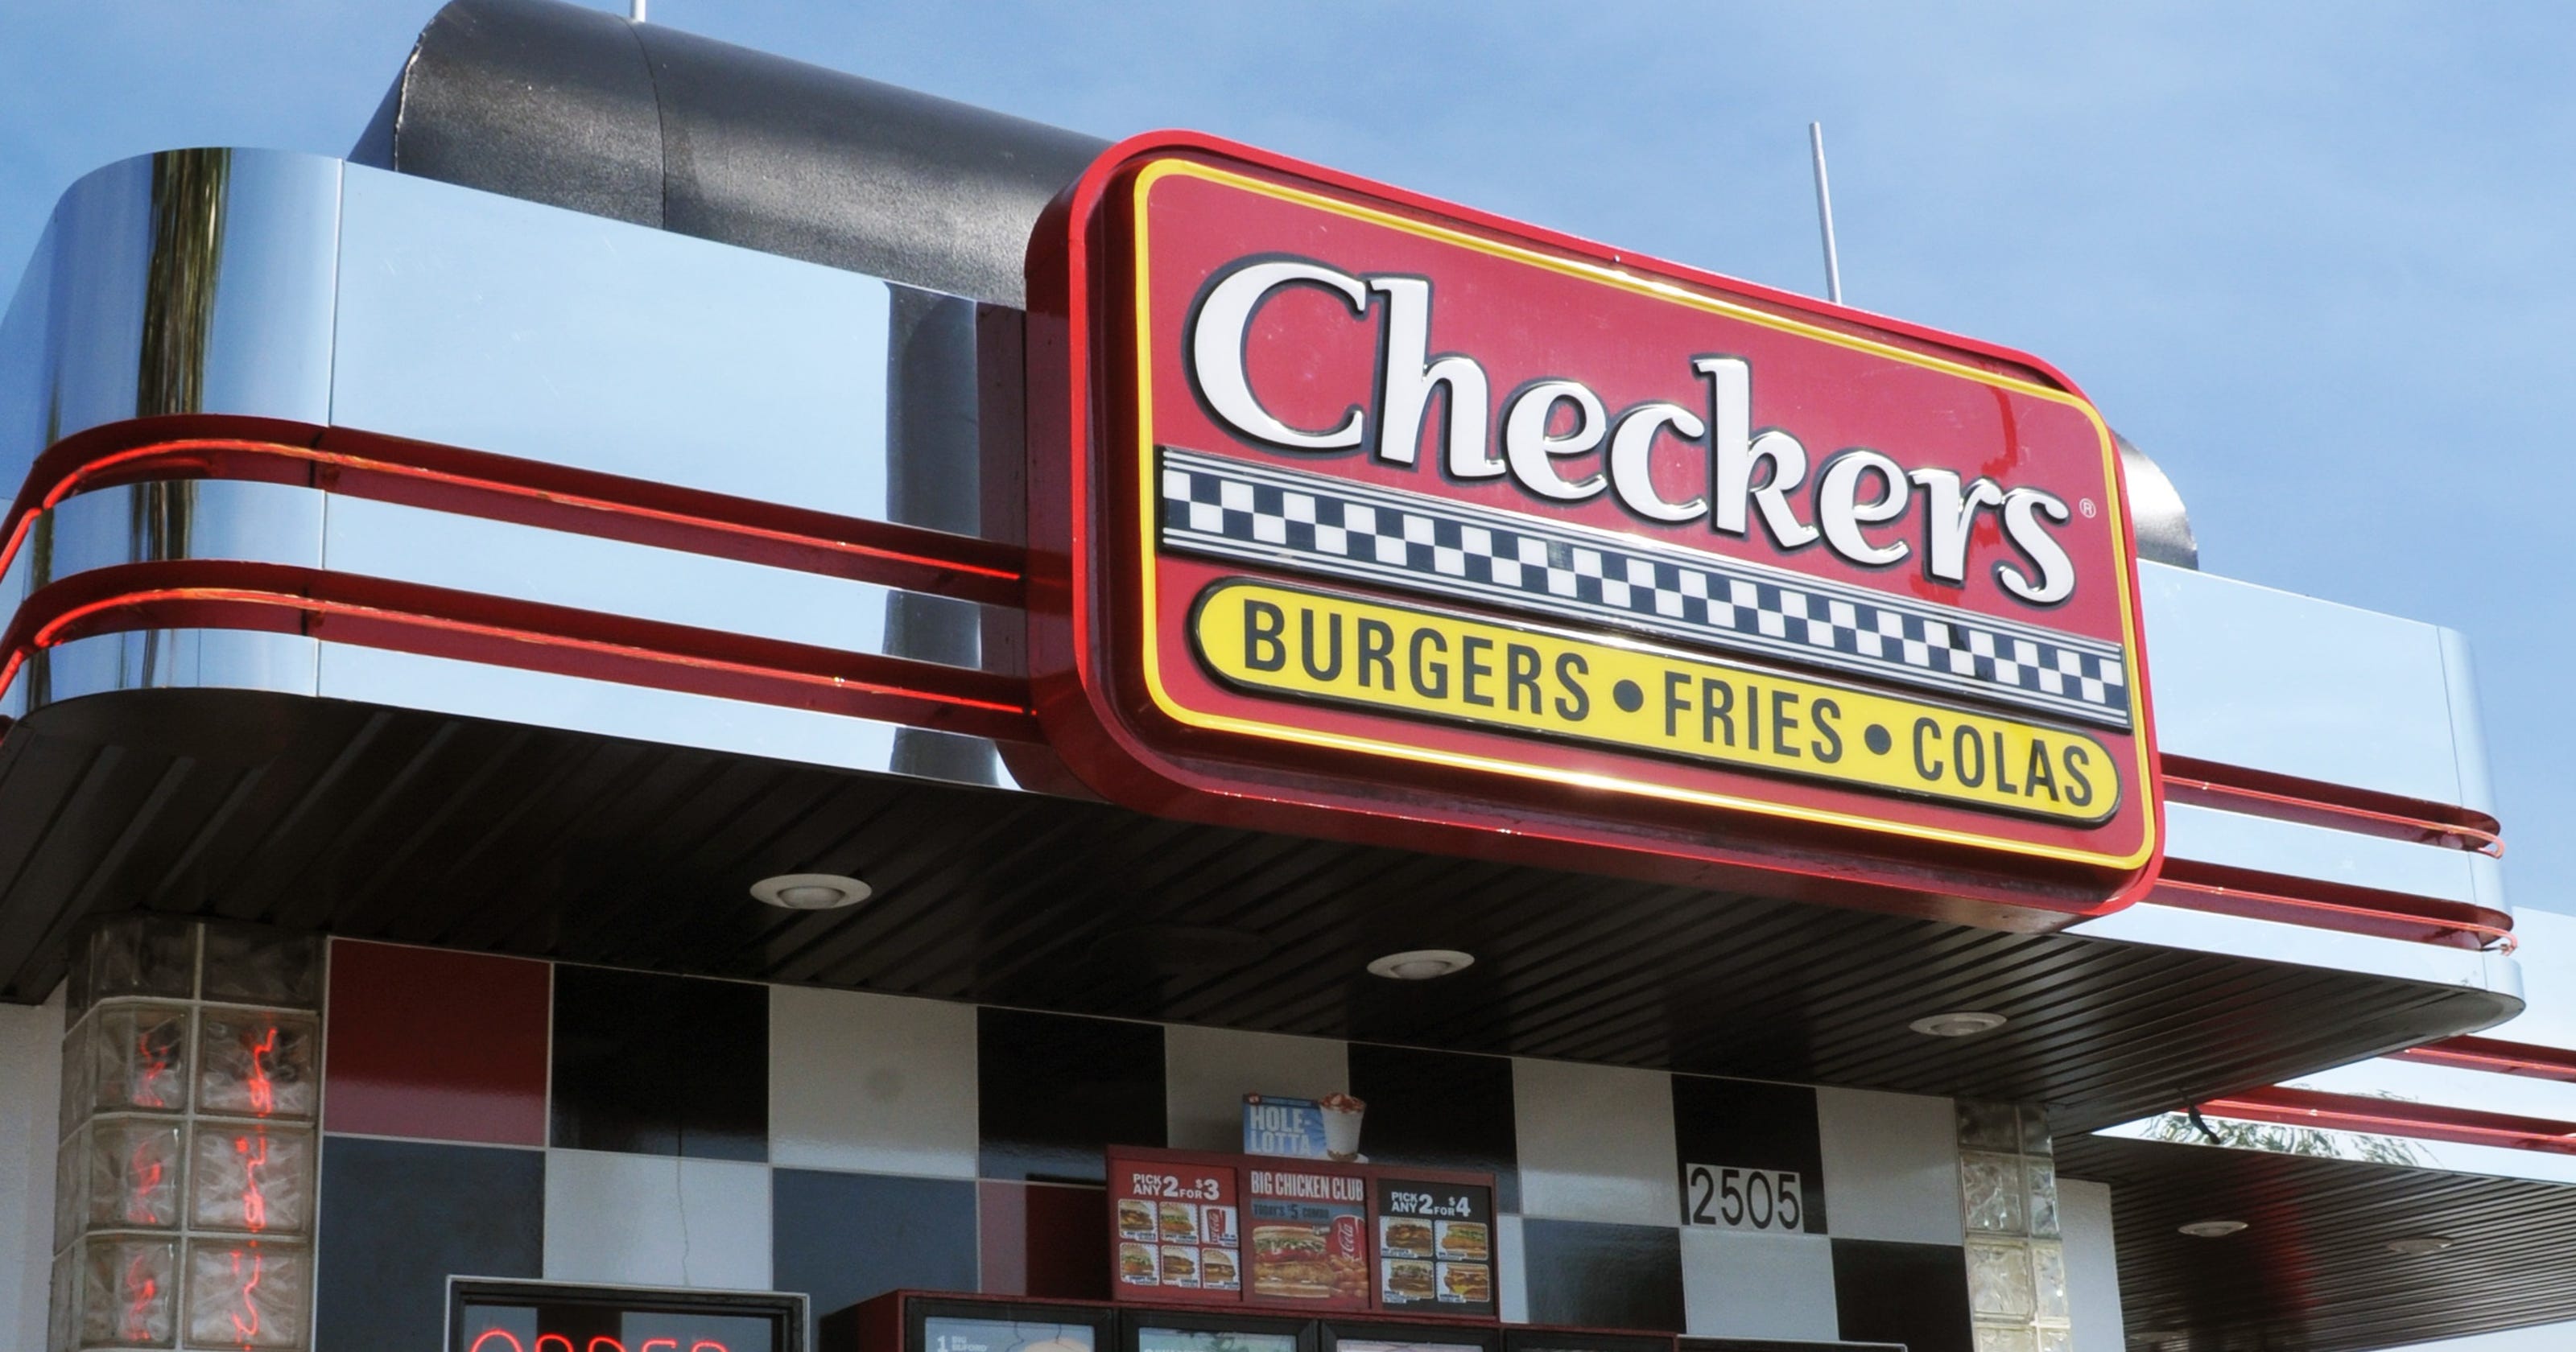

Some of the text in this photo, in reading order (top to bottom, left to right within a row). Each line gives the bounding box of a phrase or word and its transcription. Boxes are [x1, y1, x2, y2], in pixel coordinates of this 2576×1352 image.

[1189, 259, 2079, 605] Checkers
[1244, 600, 1591, 723] BURGERS
[1664, 671, 1845, 764] FRIES
[1912, 716, 2094, 808] COLAS
[1251, 1131, 1312, 1156] LOTTA
[1133, 1173, 1162, 1185] PICK
[1133, 1185, 1161, 1197] ANY
[1163, 1176, 1179, 1197] 2
[1180, 1189, 1203, 1200] FOR
[1251, 1171, 1364, 1202] BIG CHICKEN CLUB
[1391, 1191, 1418, 1202] PICK
[1391, 1202, 1418, 1214] ANY
[1418, 1193, 1433, 1214] 2
[1434, 1206, 1455, 1216] FOR
[1690, 1166, 1800, 1230] 2505
